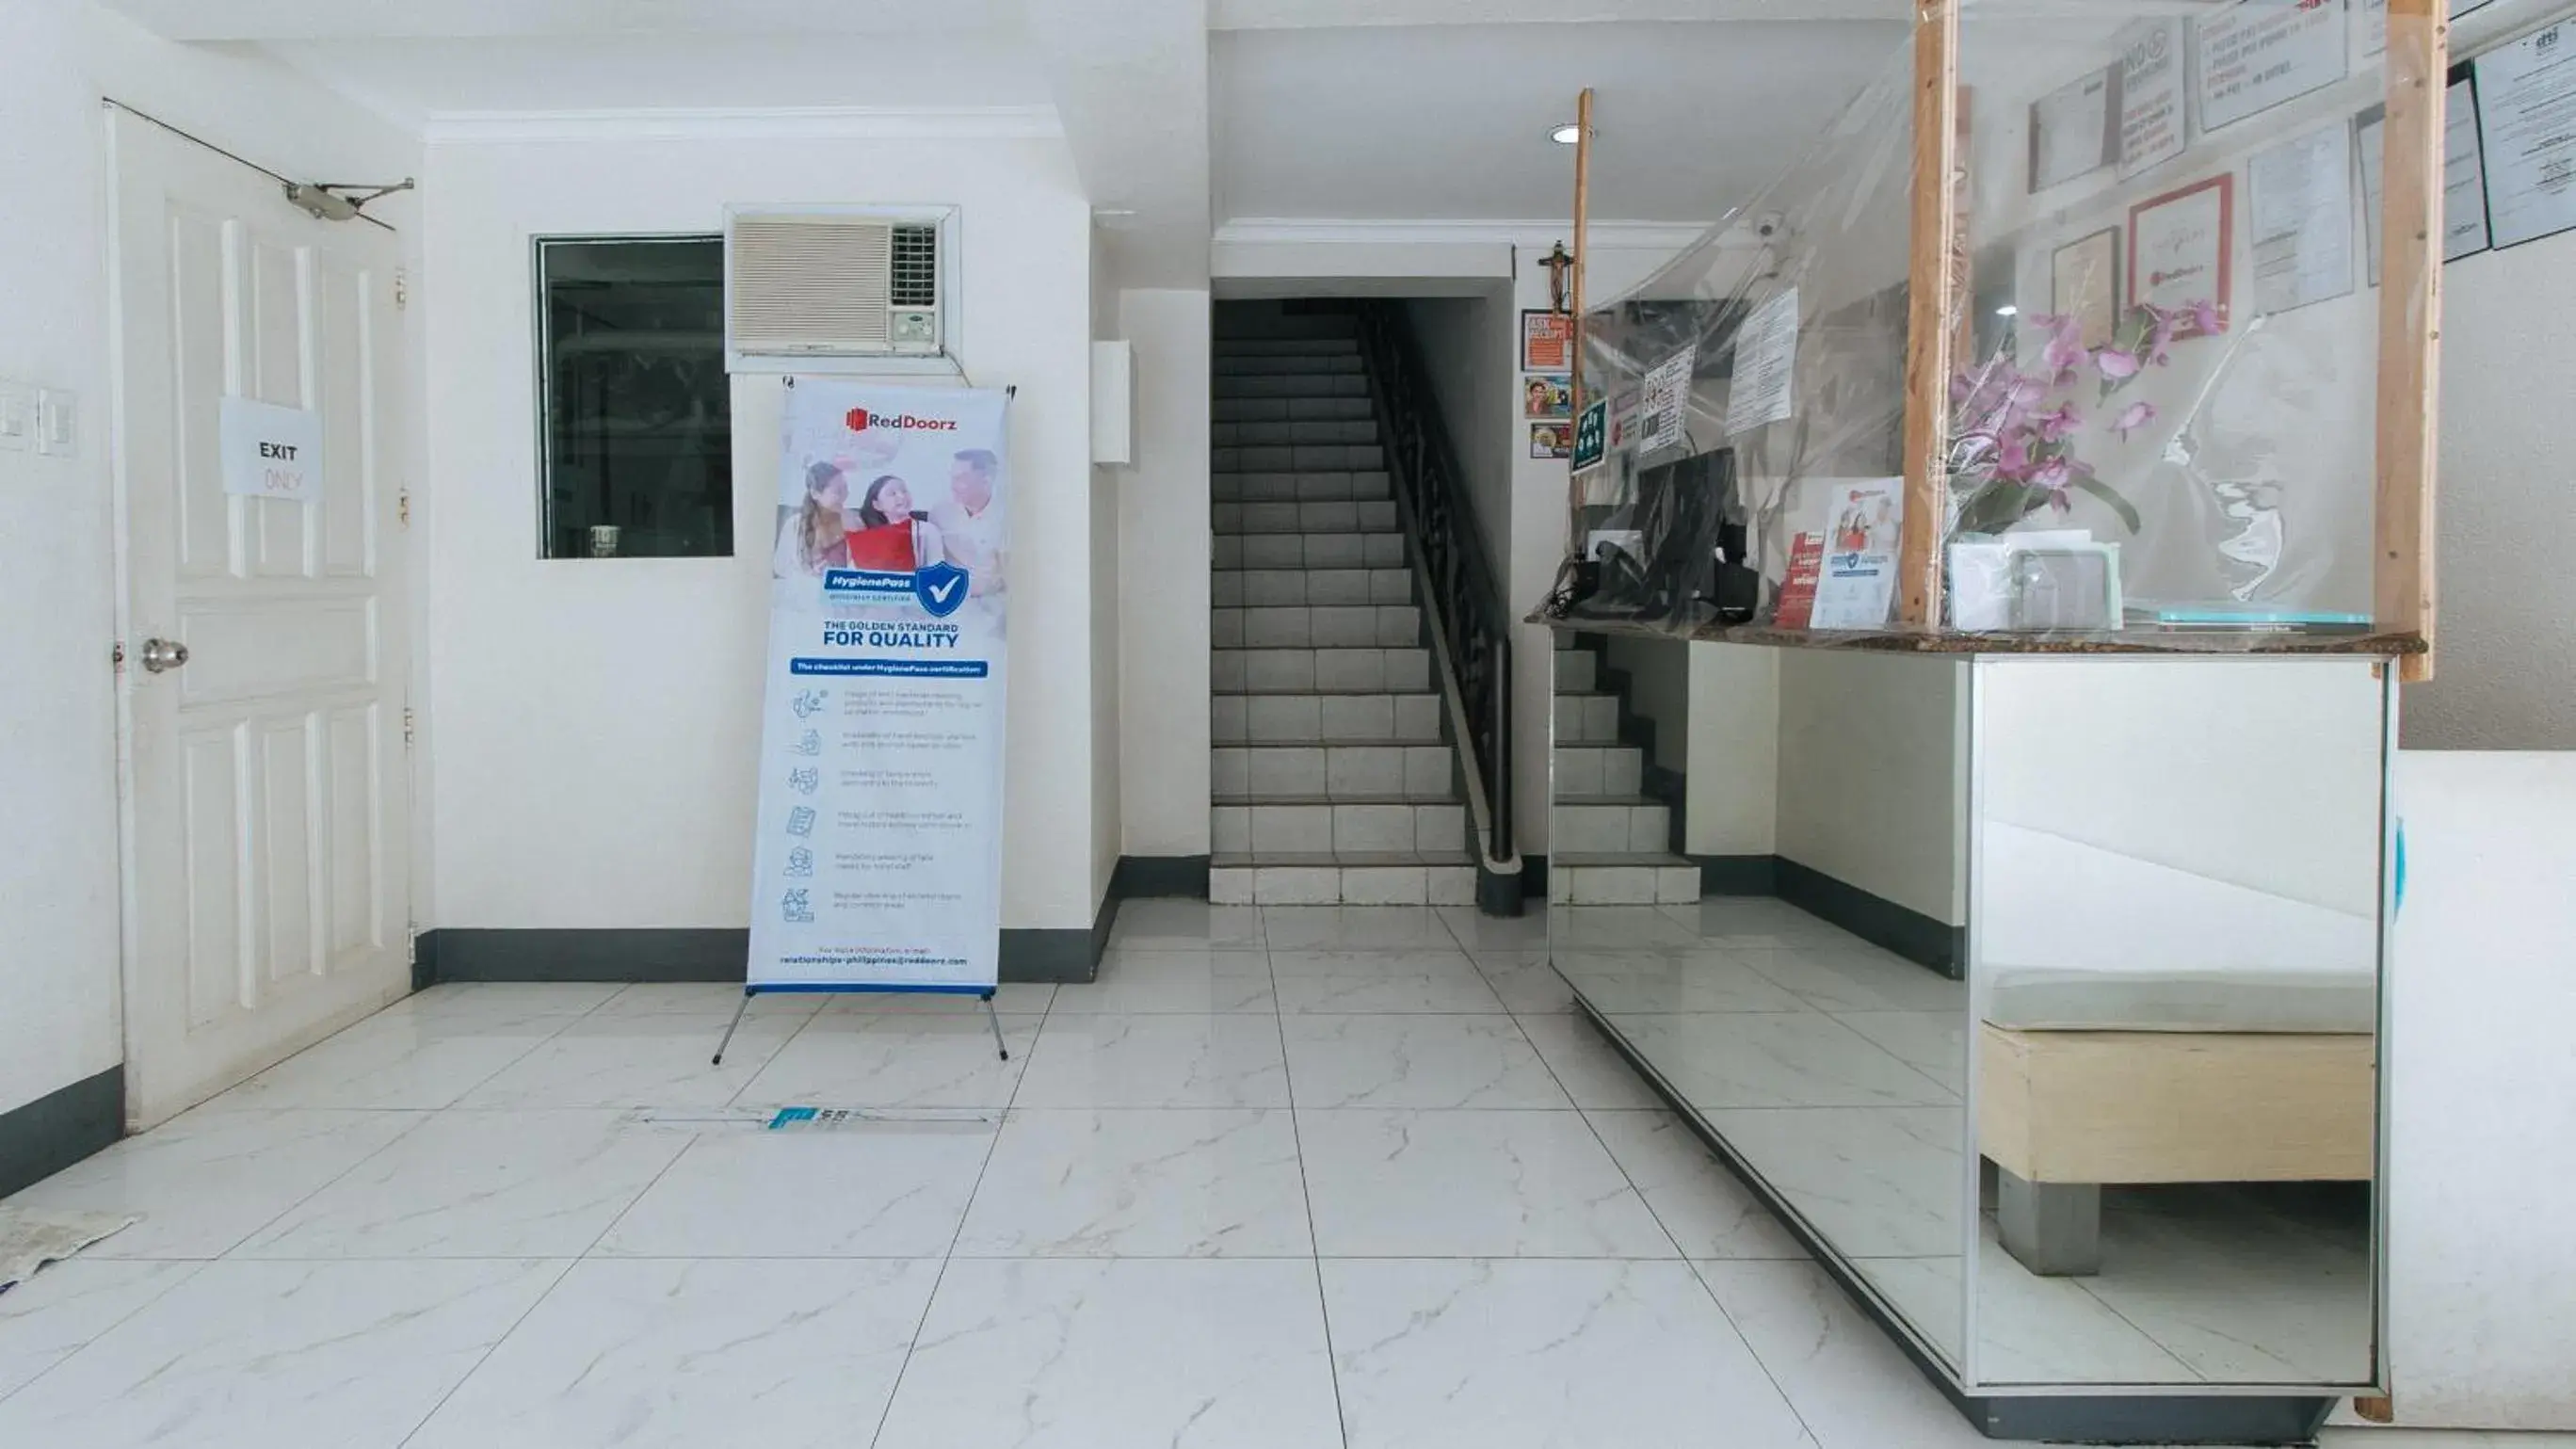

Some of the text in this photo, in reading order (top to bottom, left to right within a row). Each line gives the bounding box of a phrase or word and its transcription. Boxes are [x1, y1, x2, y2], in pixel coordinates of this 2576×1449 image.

[868, 413, 958, 431] RedDoorz
[259, 442, 298, 461] EXIT
[265, 468, 303, 491] ONLY
[831, 576, 911, 588] HygienePass
[824, 620, 958, 633] THE GOLDEN STANDARD
[823, 632, 959, 648] FOR QUALITY
